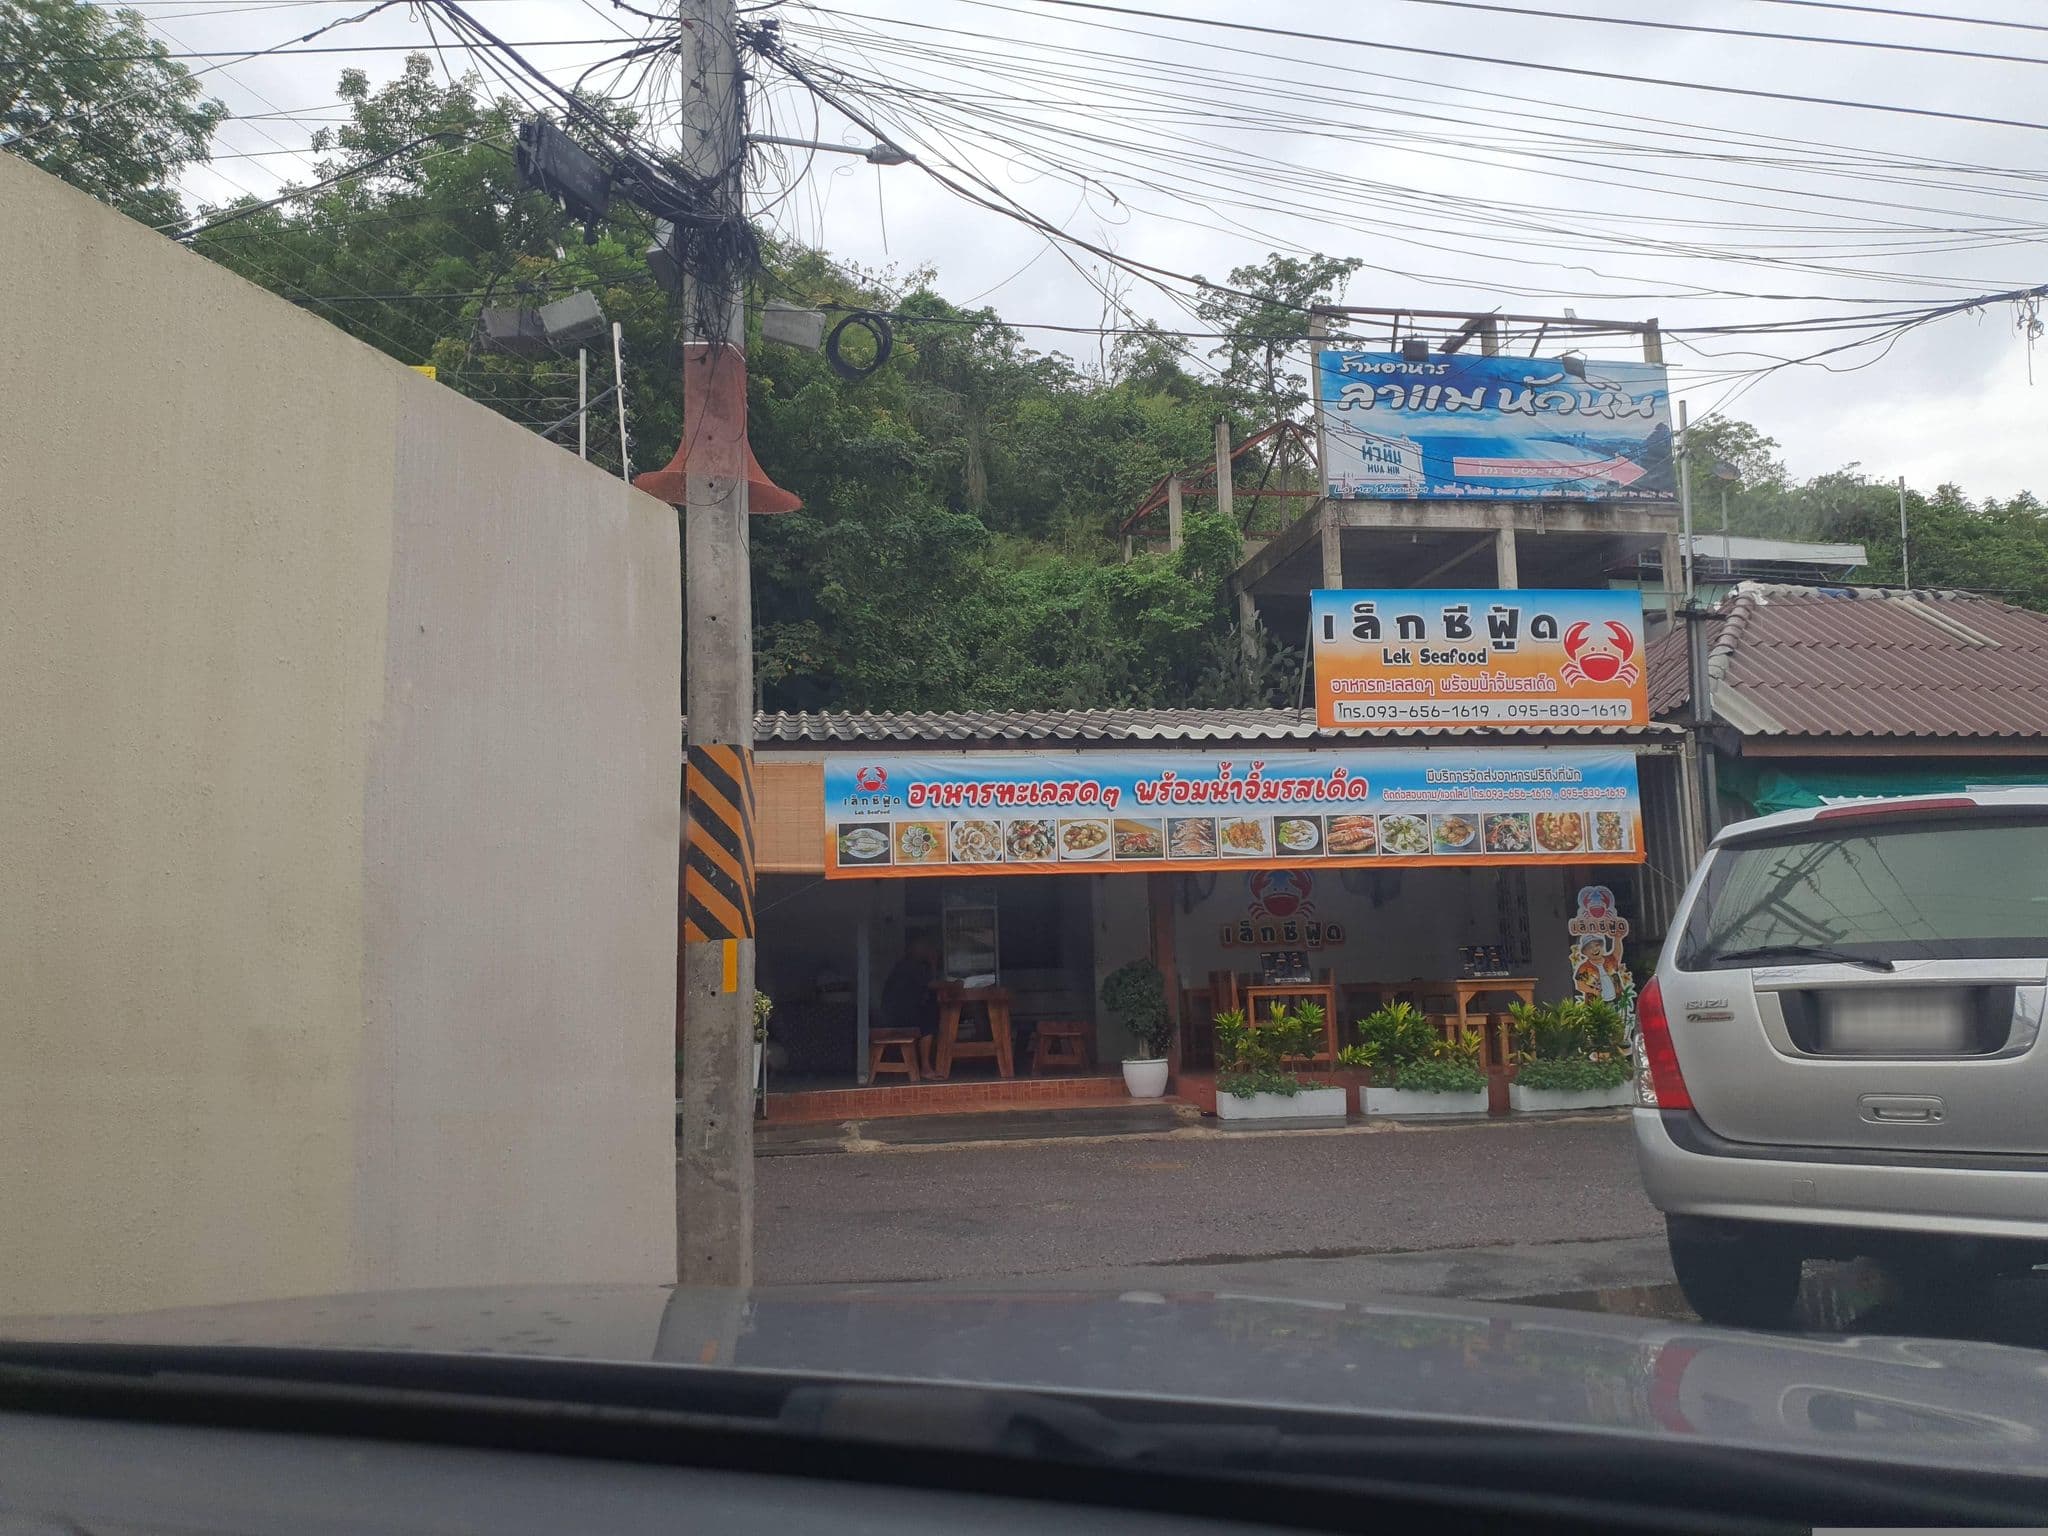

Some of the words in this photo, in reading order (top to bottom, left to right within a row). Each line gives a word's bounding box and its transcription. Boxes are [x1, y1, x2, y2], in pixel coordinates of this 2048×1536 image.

[1340, 354, 1451, 375] ร้านอาหาร
[1383, 648, 1411, 664] Lek
[1420, 647, 1487, 664] Seafood
[1331, 678, 1434, 696] อาหารทะเลสดๆ
[1440, 672, 1557, 692] พร้อมน้ำจิ้มรสเด็ด
[1337, 702, 1490, 719] โทร.093-656-1619
[1507, 703, 1627, 719] 095-830-1619
[910, 782, 1121, 809] อาหารทะเลสดๆ
[1135, 760, 1368, 802] พร้อมน้ำจิ้มรสเด็ด
